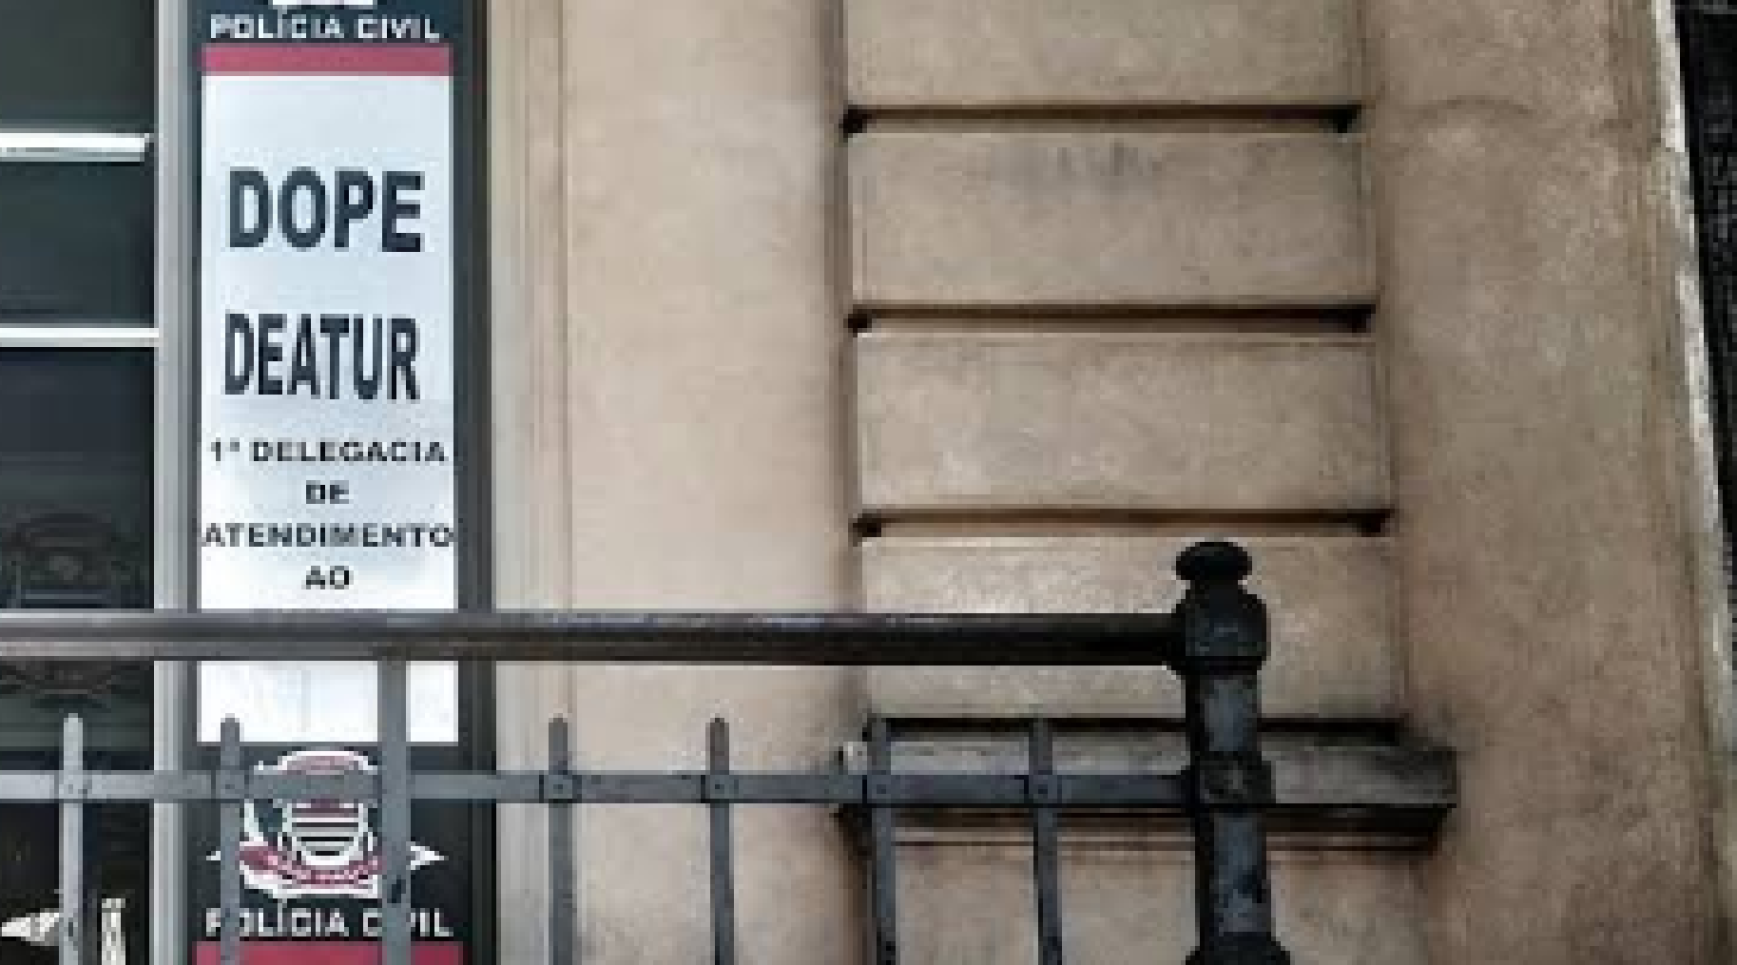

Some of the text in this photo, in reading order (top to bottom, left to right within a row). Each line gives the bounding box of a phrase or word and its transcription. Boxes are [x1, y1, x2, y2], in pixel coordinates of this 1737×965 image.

[357, 13, 440, 41] CIVIL
[227, 165, 426, 253] DOPE
[224, 309, 421, 400] DEATUR
[252, 440, 448, 463] DELEGACIA
[304, 480, 350, 505] DE
[202, 523, 456, 548] ATENDIMENTO
[302, 565, 354, 591] AO
